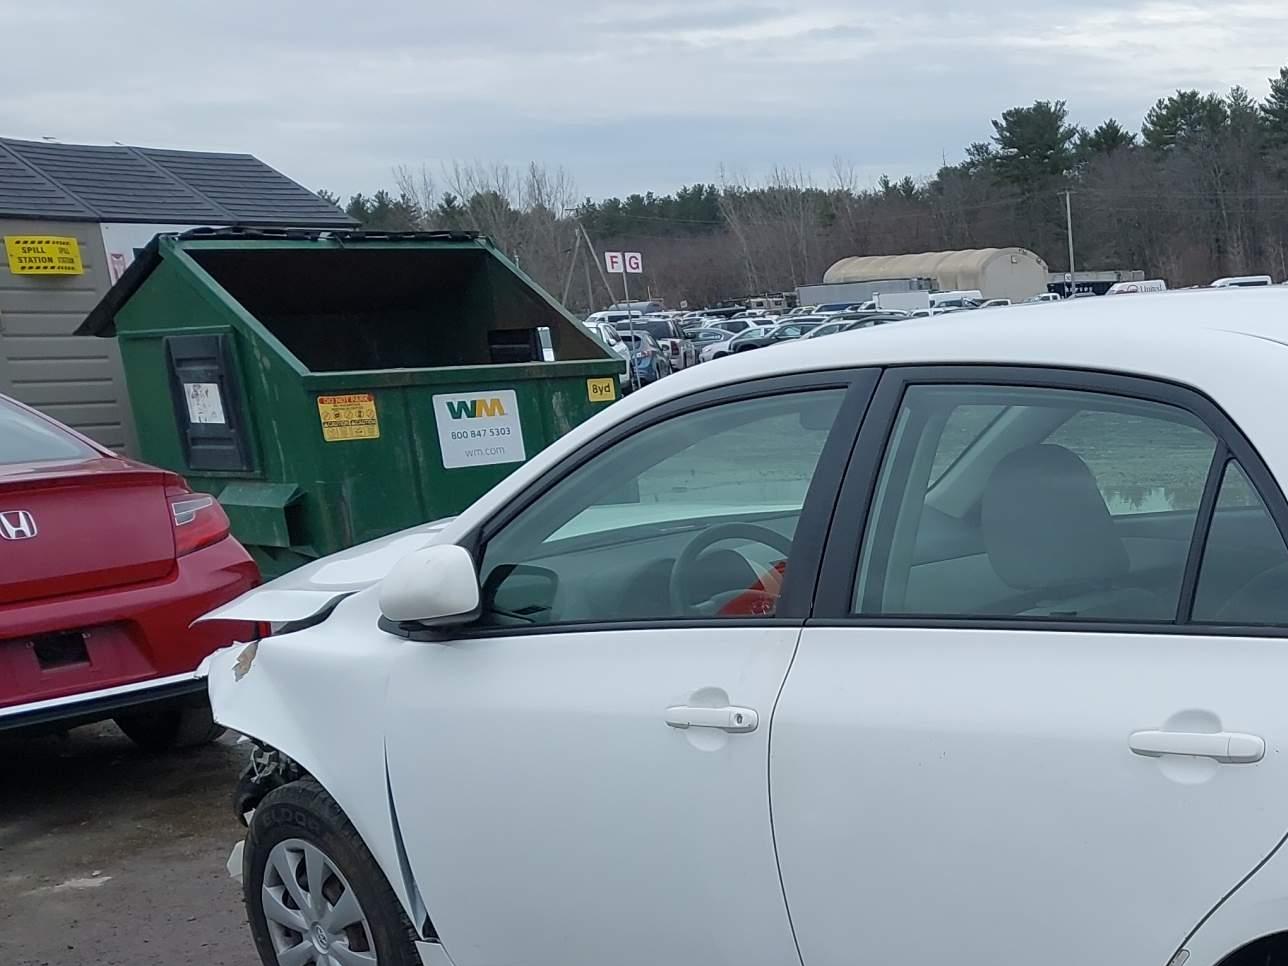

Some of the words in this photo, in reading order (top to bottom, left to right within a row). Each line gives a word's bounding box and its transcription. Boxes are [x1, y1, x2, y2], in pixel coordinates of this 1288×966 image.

[21, 246, 46, 254] SPILL
[17, 256, 53, 264] STATION
[610, 255, 619, 270] F
[628, 255, 640, 270] G
[592, 383, 611, 395] 8yd
[446, 399, 505, 419] WM
[451, 430, 468, 440] 800
[470, 429, 487, 439] 847
[489, 427, 511, 437] 5303
[464, 446, 505, 457] wm.com
